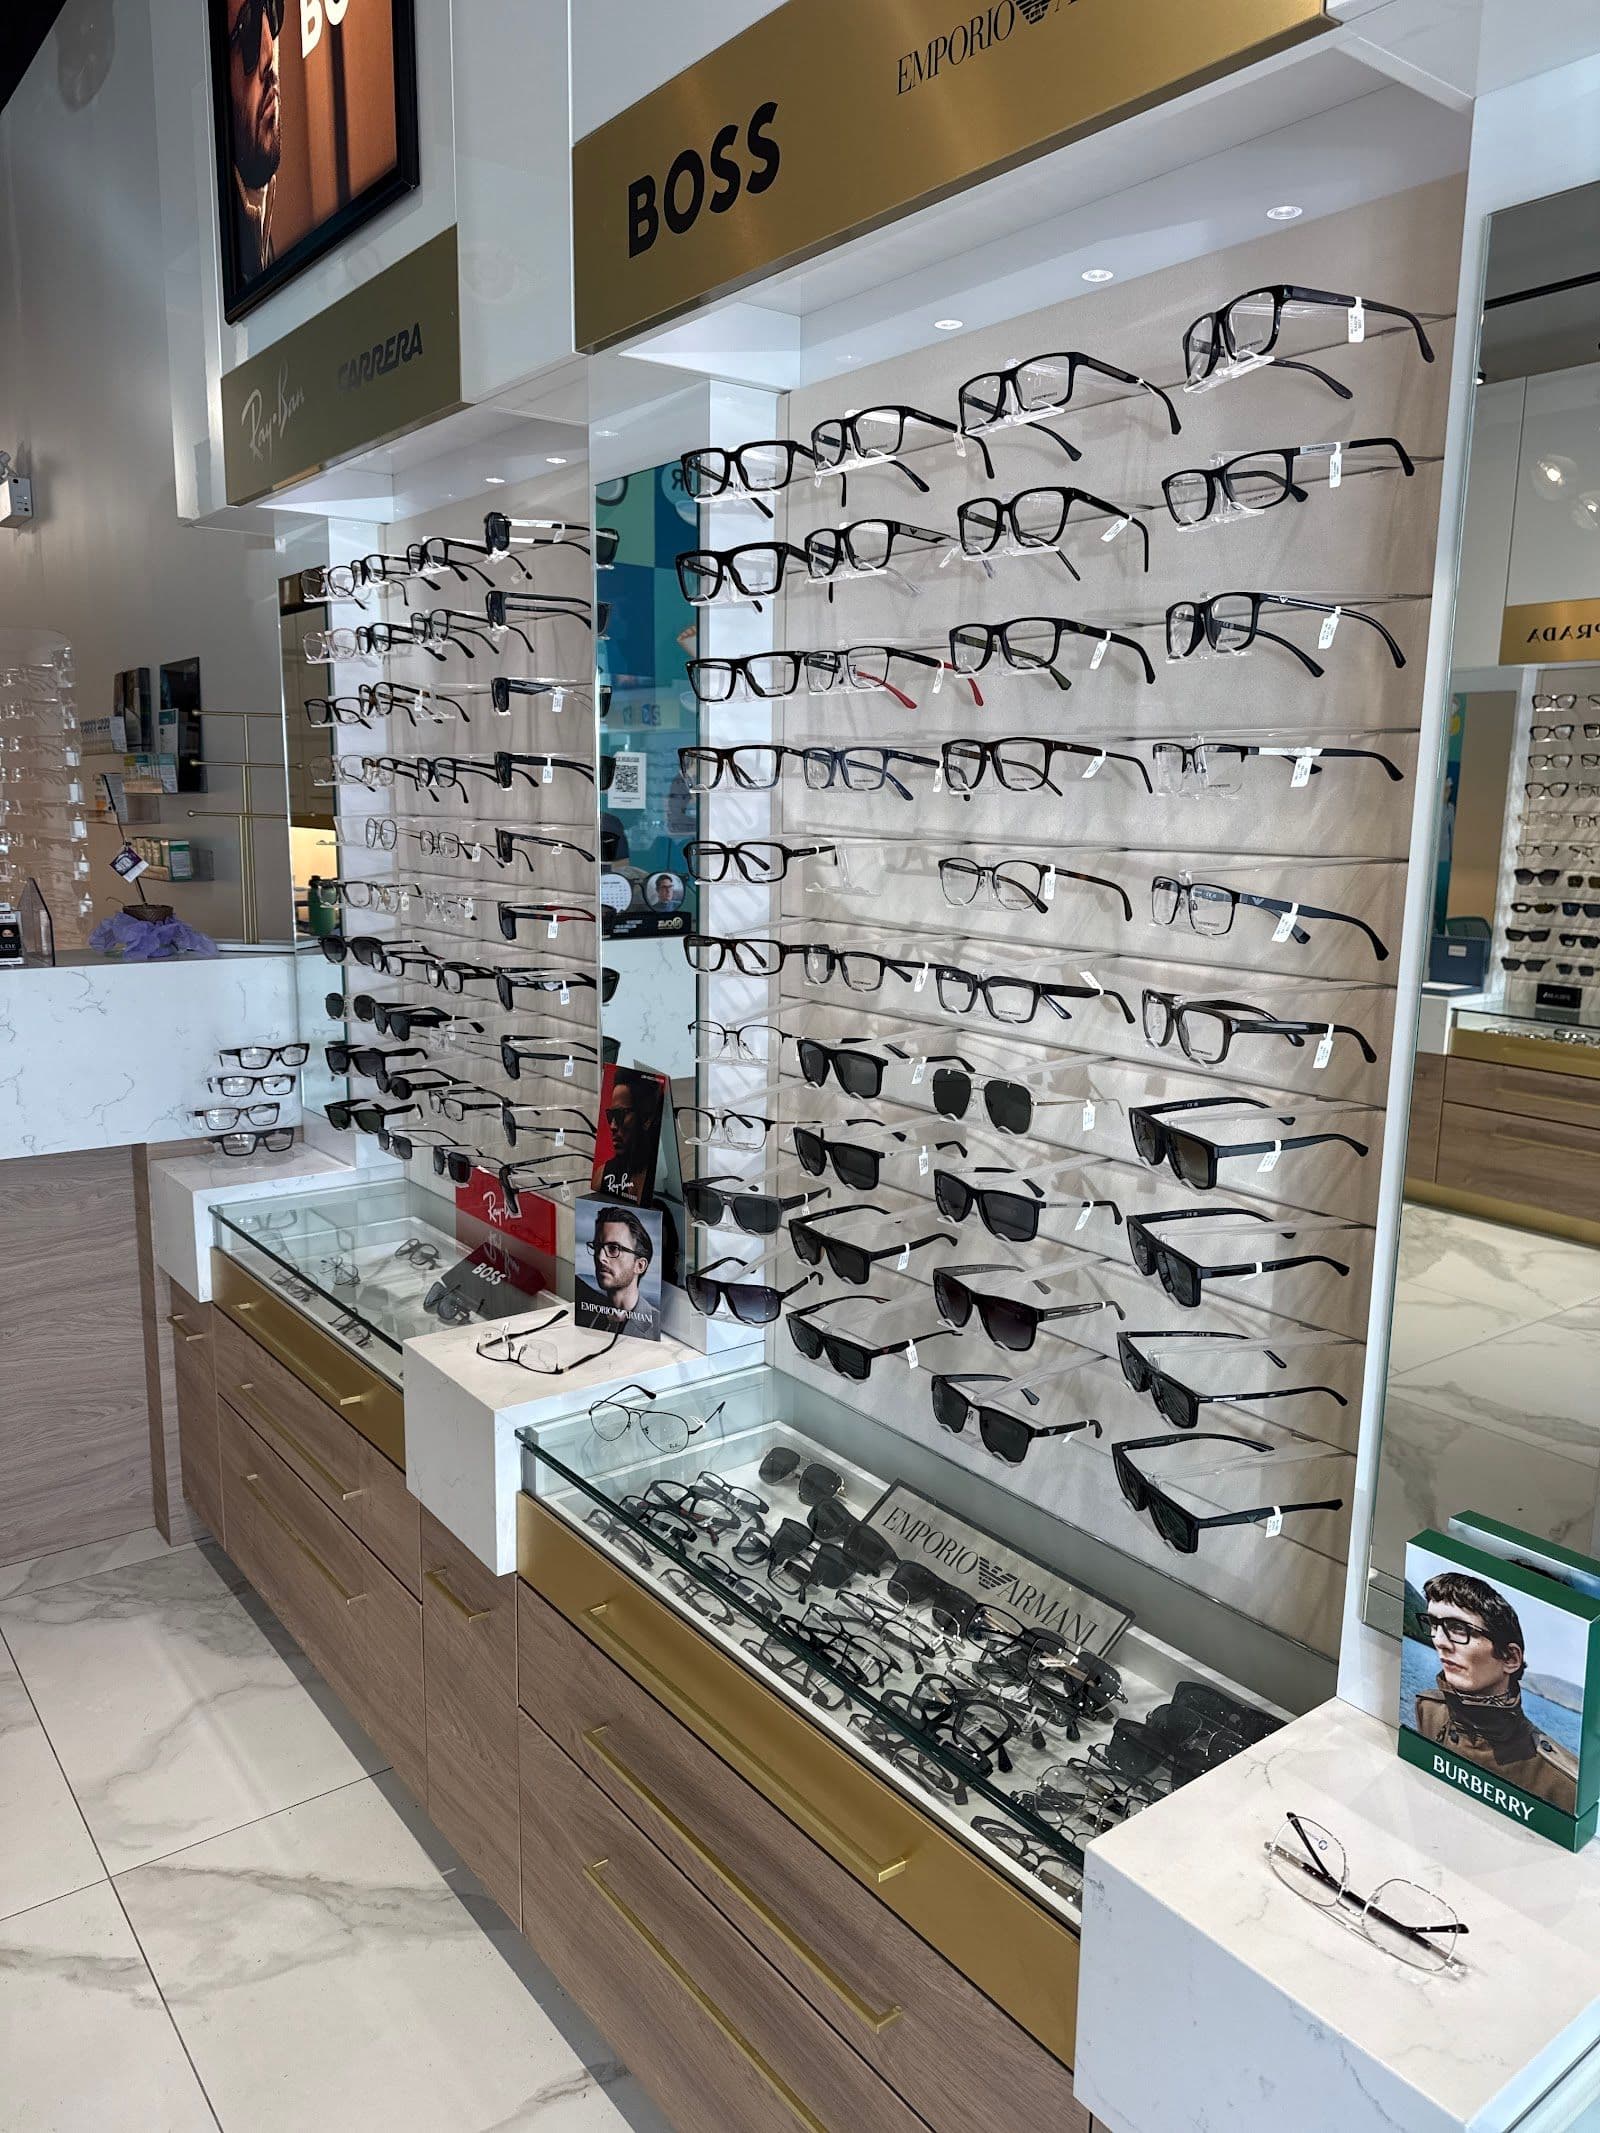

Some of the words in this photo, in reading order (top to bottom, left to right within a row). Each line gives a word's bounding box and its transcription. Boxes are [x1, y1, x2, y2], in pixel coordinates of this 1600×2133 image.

[896, 0, 1015, 96] EMPORIO
[627, 101, 780, 259] BOSS
[336, 322, 423, 393] CARRERA
[241, 359, 305, 463] Ray-Ban
[604, 1172, 634, 1194] Ray-Ban
[472, 1262, 507, 1285] BOSS
[581, 1301, 614, 1316] EMPORIO
[624, 1310, 653, 1323] ARMANI
[881, 1506, 979, 1576] EMPORIO
[996, 1578, 1099, 1646] ARMANI
[1433, 1754, 1535, 1821] BURBERRY
